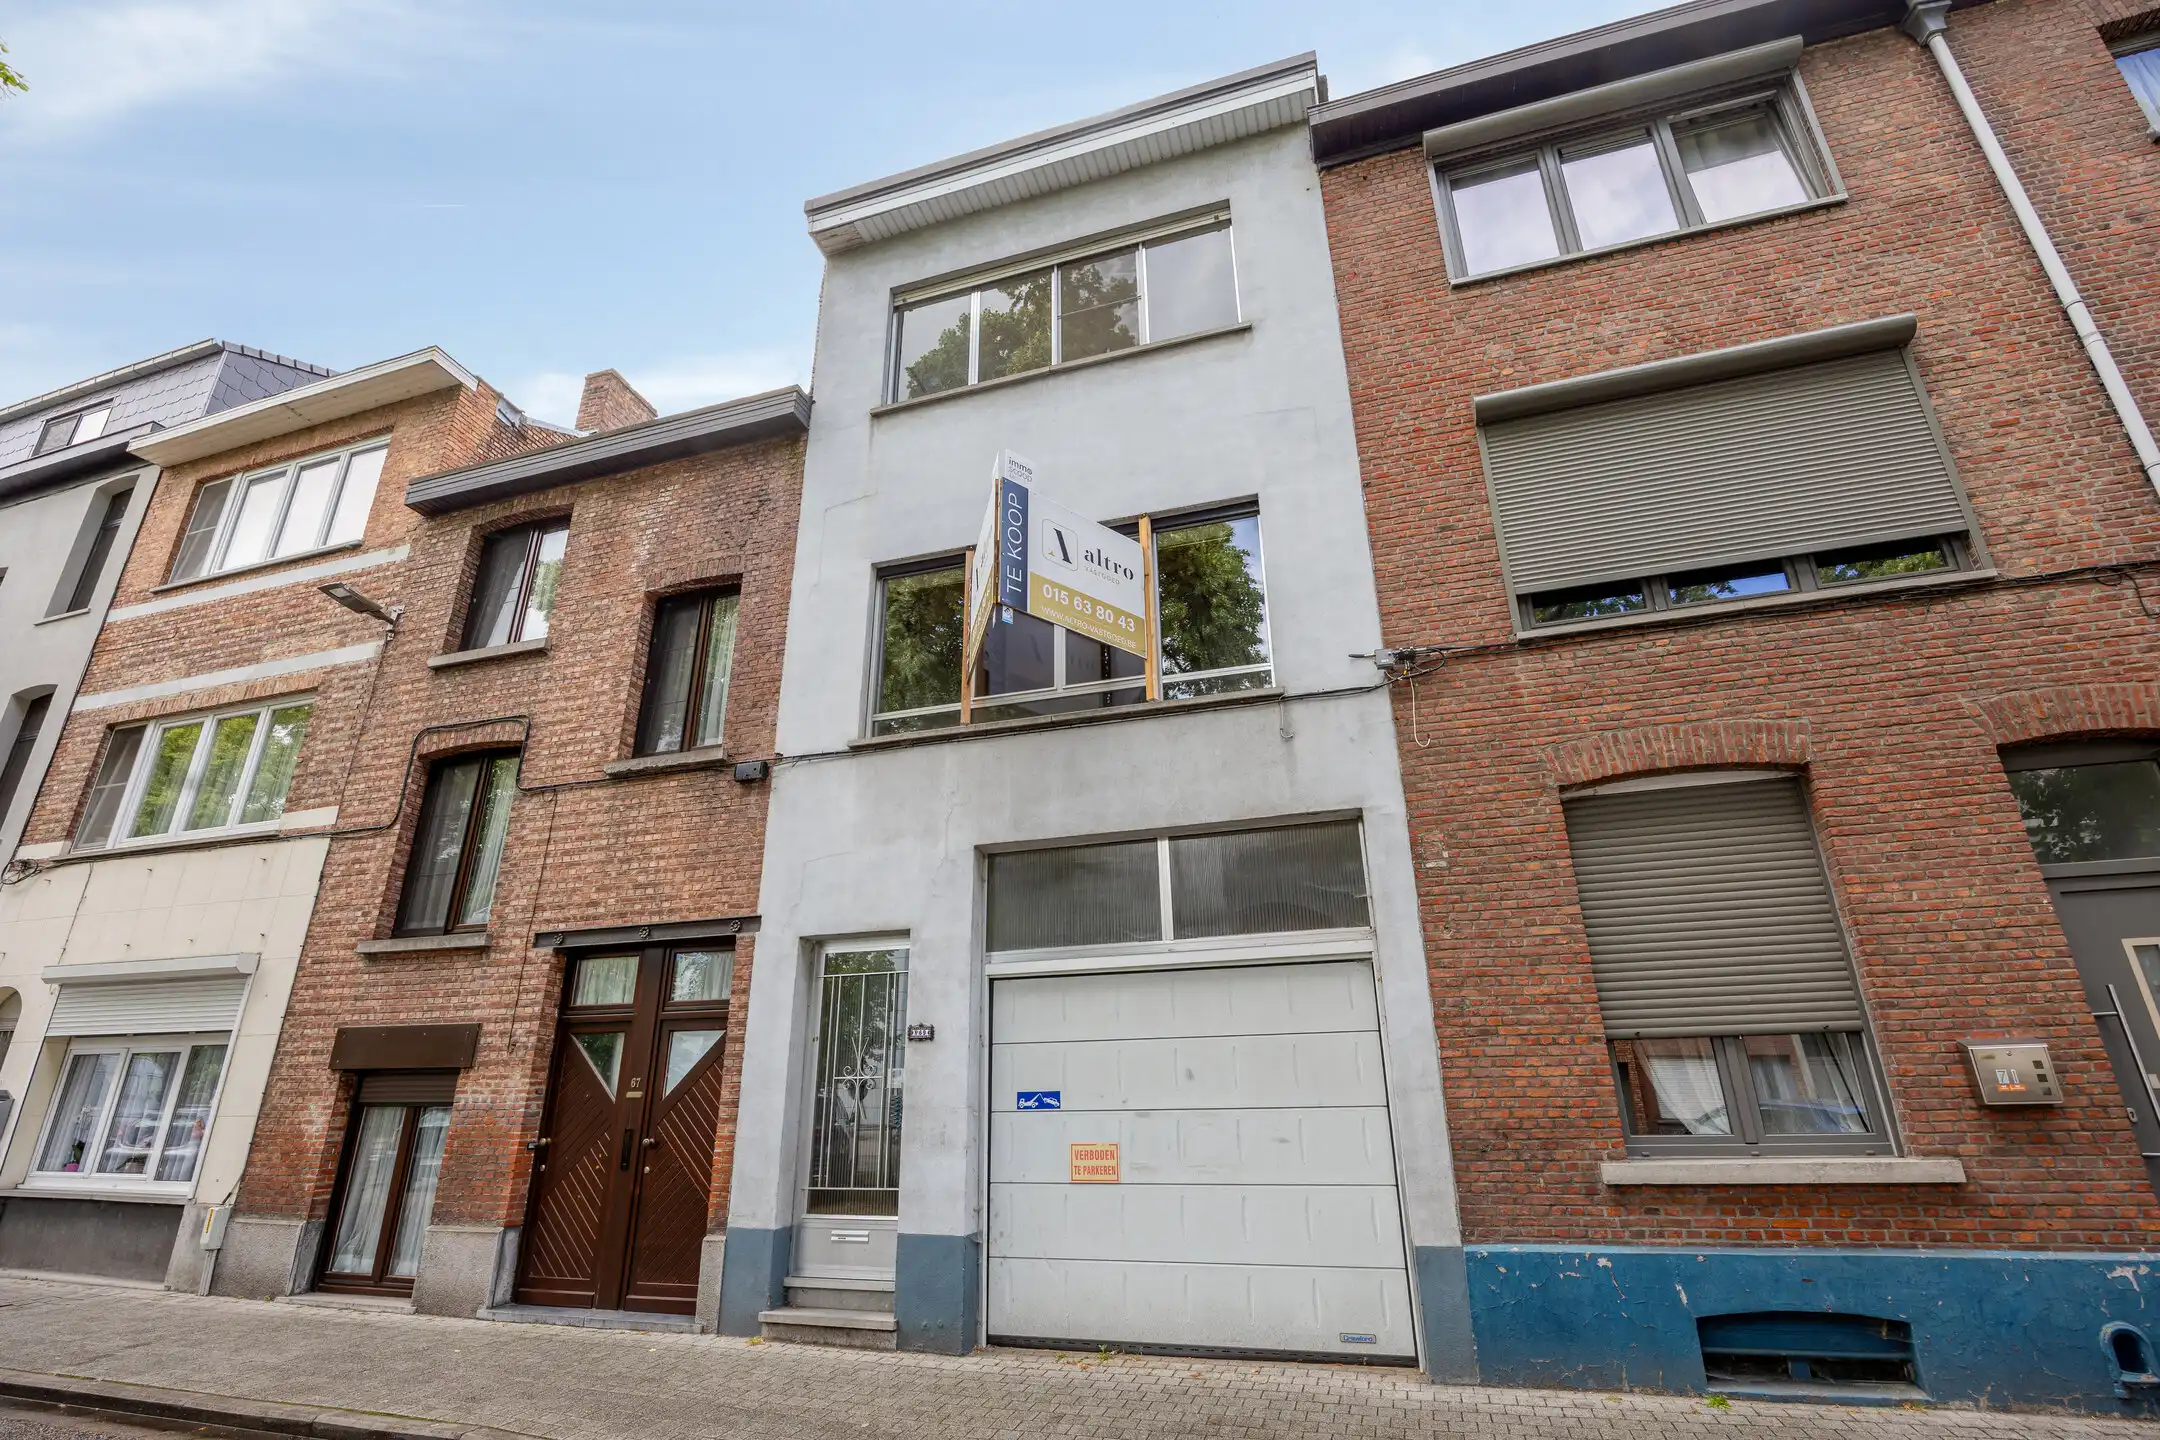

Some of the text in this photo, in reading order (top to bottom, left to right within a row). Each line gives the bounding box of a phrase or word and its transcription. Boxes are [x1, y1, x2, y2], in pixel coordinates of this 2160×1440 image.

[1007, 492, 1023, 562] KOOP
[1084, 547, 1134, 580] altro
[1006, 566, 1023, 593] TE
[1042, 584, 1136, 633] 015 63 80 43
[631, 1077, 641, 1088] 67
[1074, 1150, 1115, 1161] VERBODEN
[1074, 1165, 1116, 1175] TE PARKEREN
